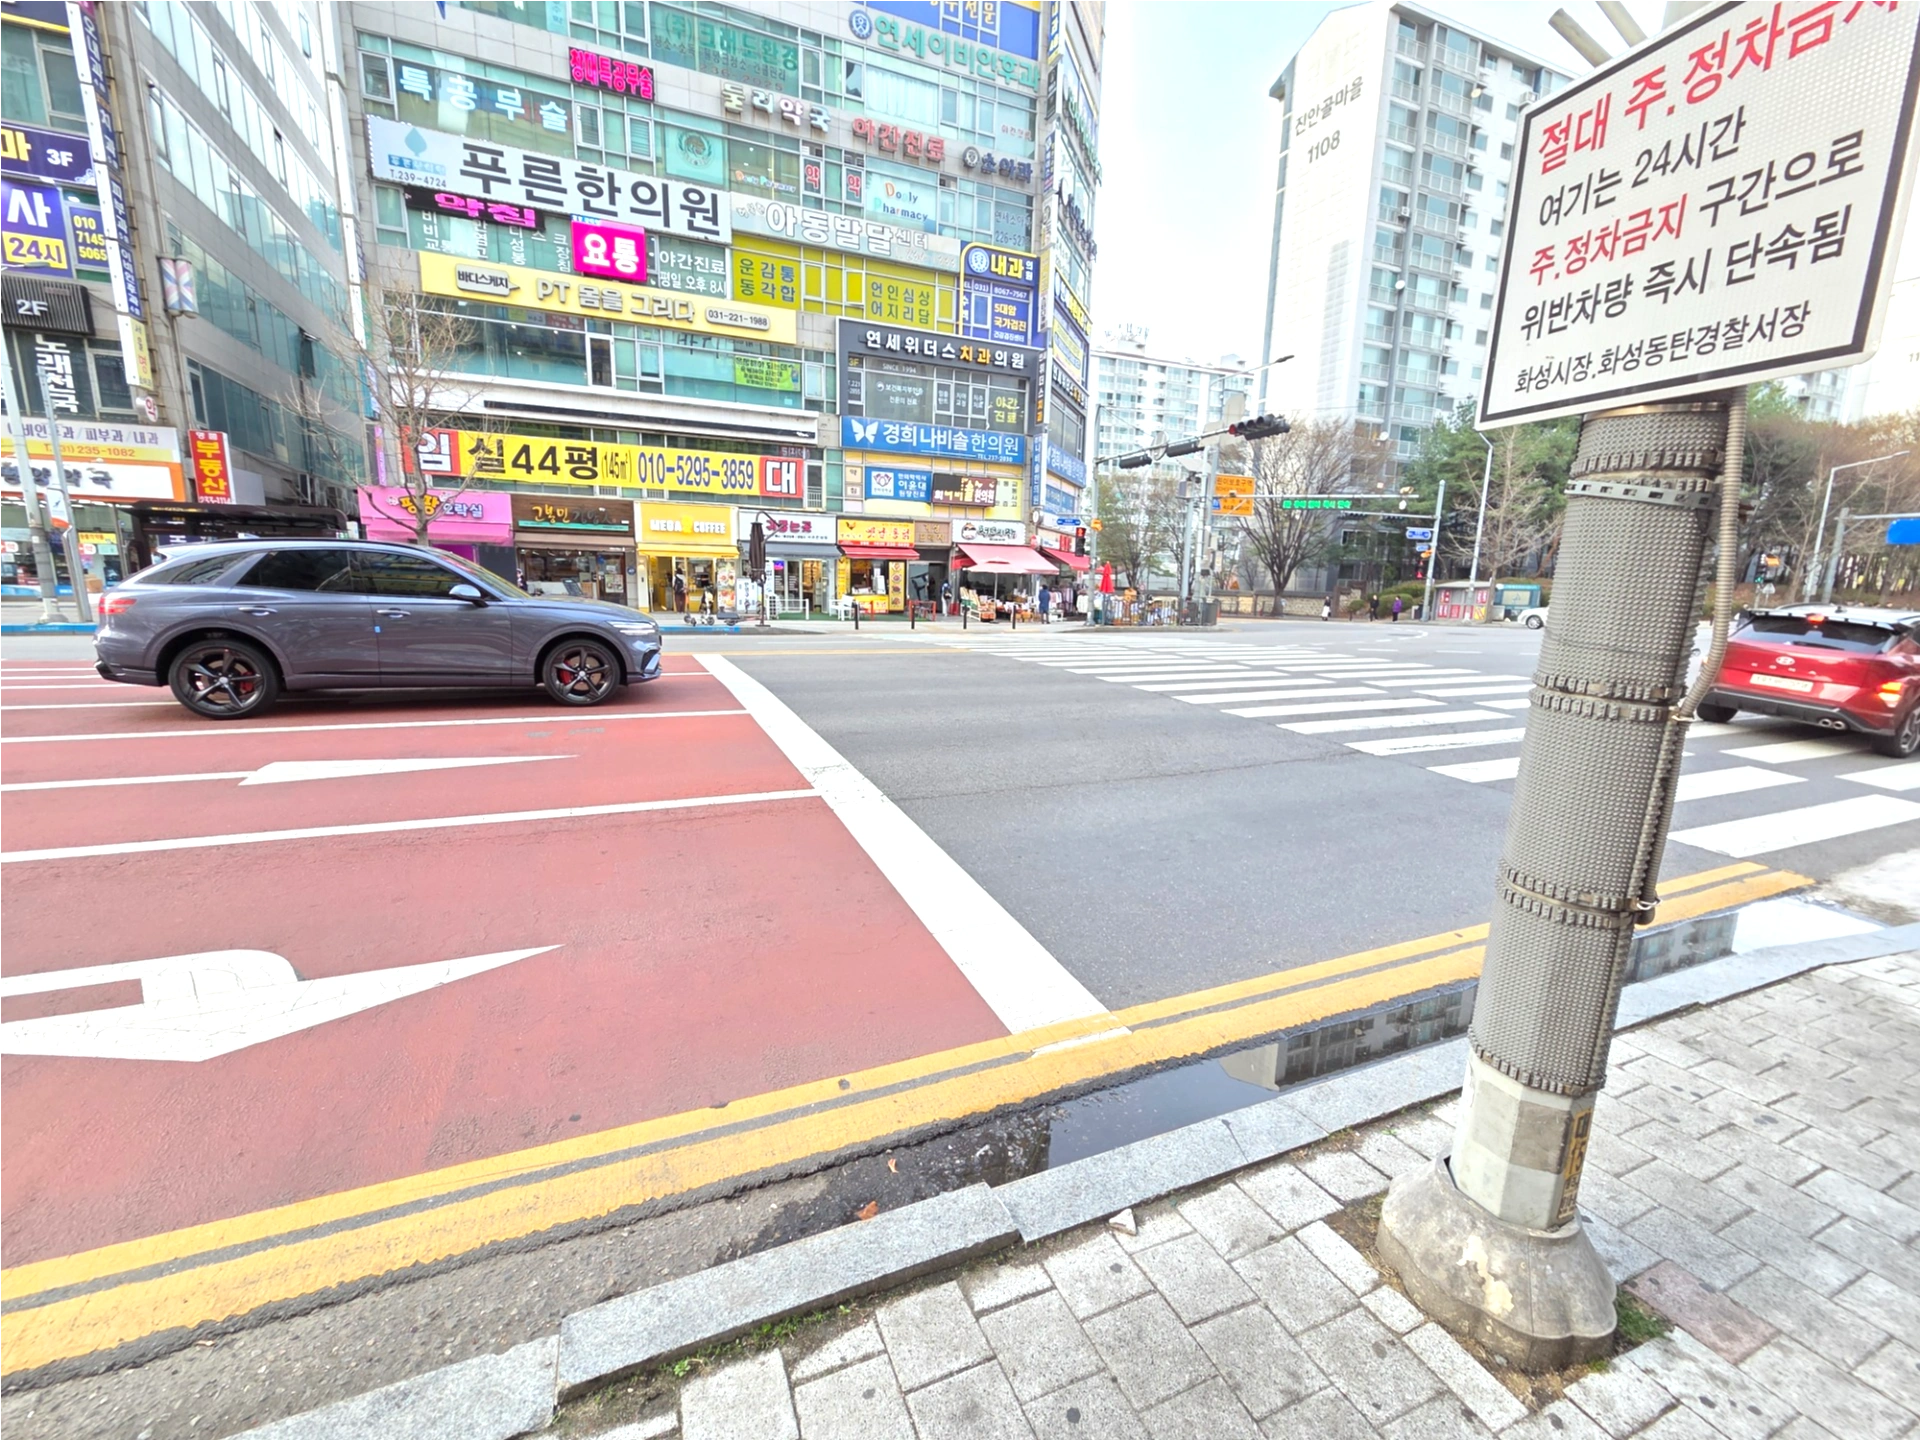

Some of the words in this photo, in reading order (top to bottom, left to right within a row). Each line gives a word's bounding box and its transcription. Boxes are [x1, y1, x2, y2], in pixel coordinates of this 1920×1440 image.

[874, 14, 1040, 93] 연세이비인후과
[721, 82, 832, 133] 둘리약국
[1295, 76, 1363, 136] 진안골마을
[853, 117, 945, 162] 야간진료
[1307, 129, 1341, 164] 1108
[1538, 93, 1612, 175] 절대
[47, 148, 73, 167] 3F
[1540, 166, 1623, 227] 여기는
[1631, 105, 1746, 188] 24시간
[390, 168, 447, 188] T.239-4724
[458, 142, 722, 238] 푸른한의원
[804, 164, 820, 189] 약
[847, 174, 861, 199] 약
[74, 214, 97, 231] 010
[434, 192, 537, 228] 약침
[1528, 193, 1688, 286] 주.정차금지
[1699, 129, 1865, 227] 구간으로
[76, 230, 105, 247] 7145
[765, 201, 929, 257] 아동발달센터
[994, 231, 1031, 247] 226-527
[10, 237, 64, 265] 24시
[79, 246, 108, 262] 5065
[582, 232, 640, 274] 요통
[659, 250, 726, 275] 야간진료
[991, 253, 1025, 279] 내과
[457, 269, 510, 290] 바디스케치
[659, 270, 682, 289] 평일
[685, 275, 708, 293] 오후
[709, 279, 727, 296] 8시
[1520, 273, 1634, 341] 위반차량
[1642, 249, 1712, 304] 즉시
[1724, 204, 1852, 286] 단속됨
[16, 299, 49, 317] 2F
[536, 279, 571, 304] PT
[577, 283, 624, 313] 몸을
[630, 292, 695, 323] 그리다
[708, 309, 768, 327] 031-221-1988
[865, 330, 1026, 370] 연세위더스치과의원
[7, 421, 75, 440] 비인과
[85, 427, 124, 442] 피부과
[133, 430, 160, 446] 내과
[883, 422, 1019, 457] 경희나비솔한의원
[77, 445, 136, 458] 235-1082
[197, 440, 228, 496] 부동산
[637, 450, 755, 490] 010-5295-3859
[764, 459, 799, 495] 대
[693, 520, 726, 534] COFFEE
